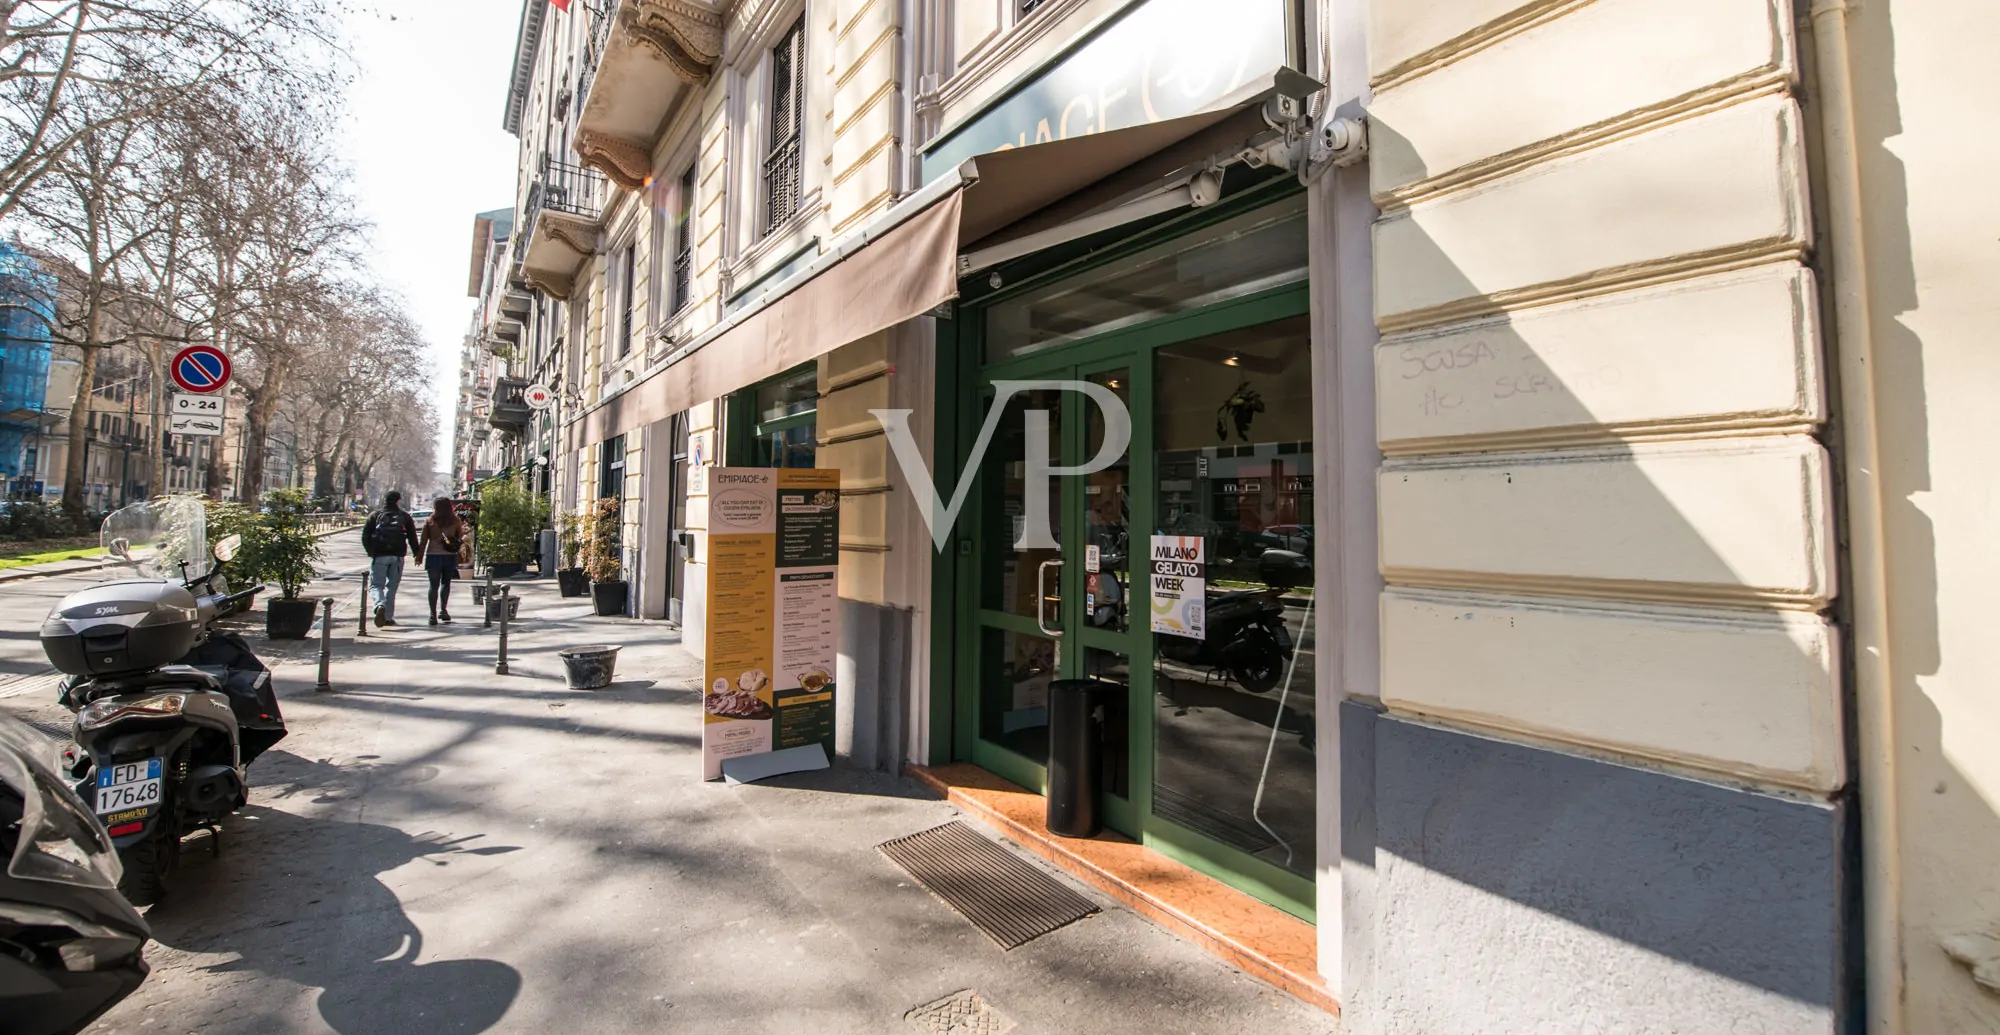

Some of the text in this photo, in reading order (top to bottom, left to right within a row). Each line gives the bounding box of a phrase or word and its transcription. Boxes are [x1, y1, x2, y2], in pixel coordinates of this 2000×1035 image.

[179, 399, 189, 408] 0
[198, 401, 217, 410] 24
[1155, 546, 1198, 560] MILANO
[1155, 561, 1199, 577] GELATO
[1155, 576, 1184, 592] WEEK
[94, 606, 120, 618] SYM
[100, 782, 159, 810] 17648
